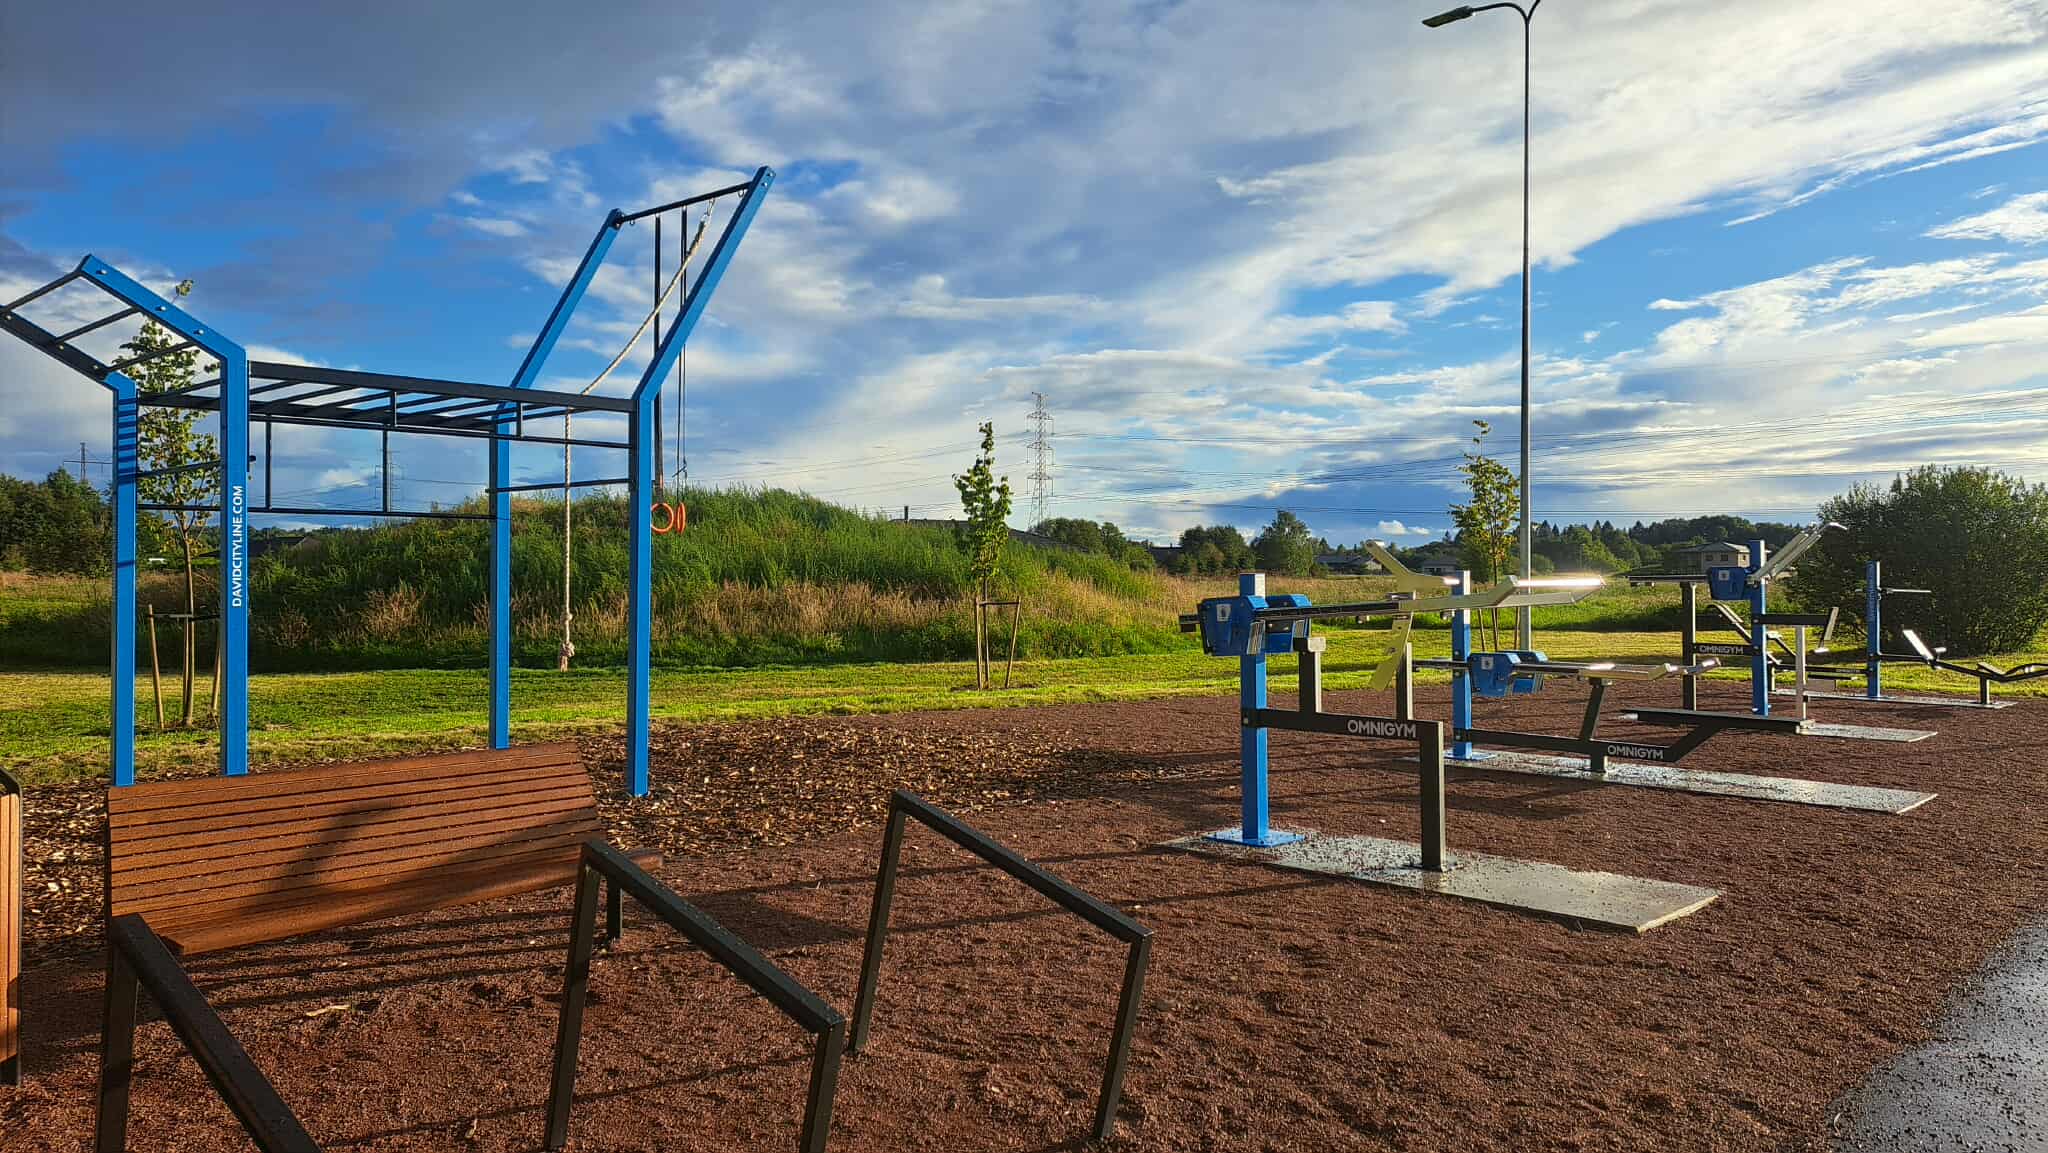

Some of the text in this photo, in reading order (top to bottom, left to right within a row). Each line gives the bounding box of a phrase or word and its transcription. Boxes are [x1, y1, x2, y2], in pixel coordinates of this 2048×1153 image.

[232, 486, 243, 607] DAVIDCITYLINE.COM
[1347, 719, 1417, 738] OMNIGYM
[1607, 744, 1664, 759] OMNIGYM
